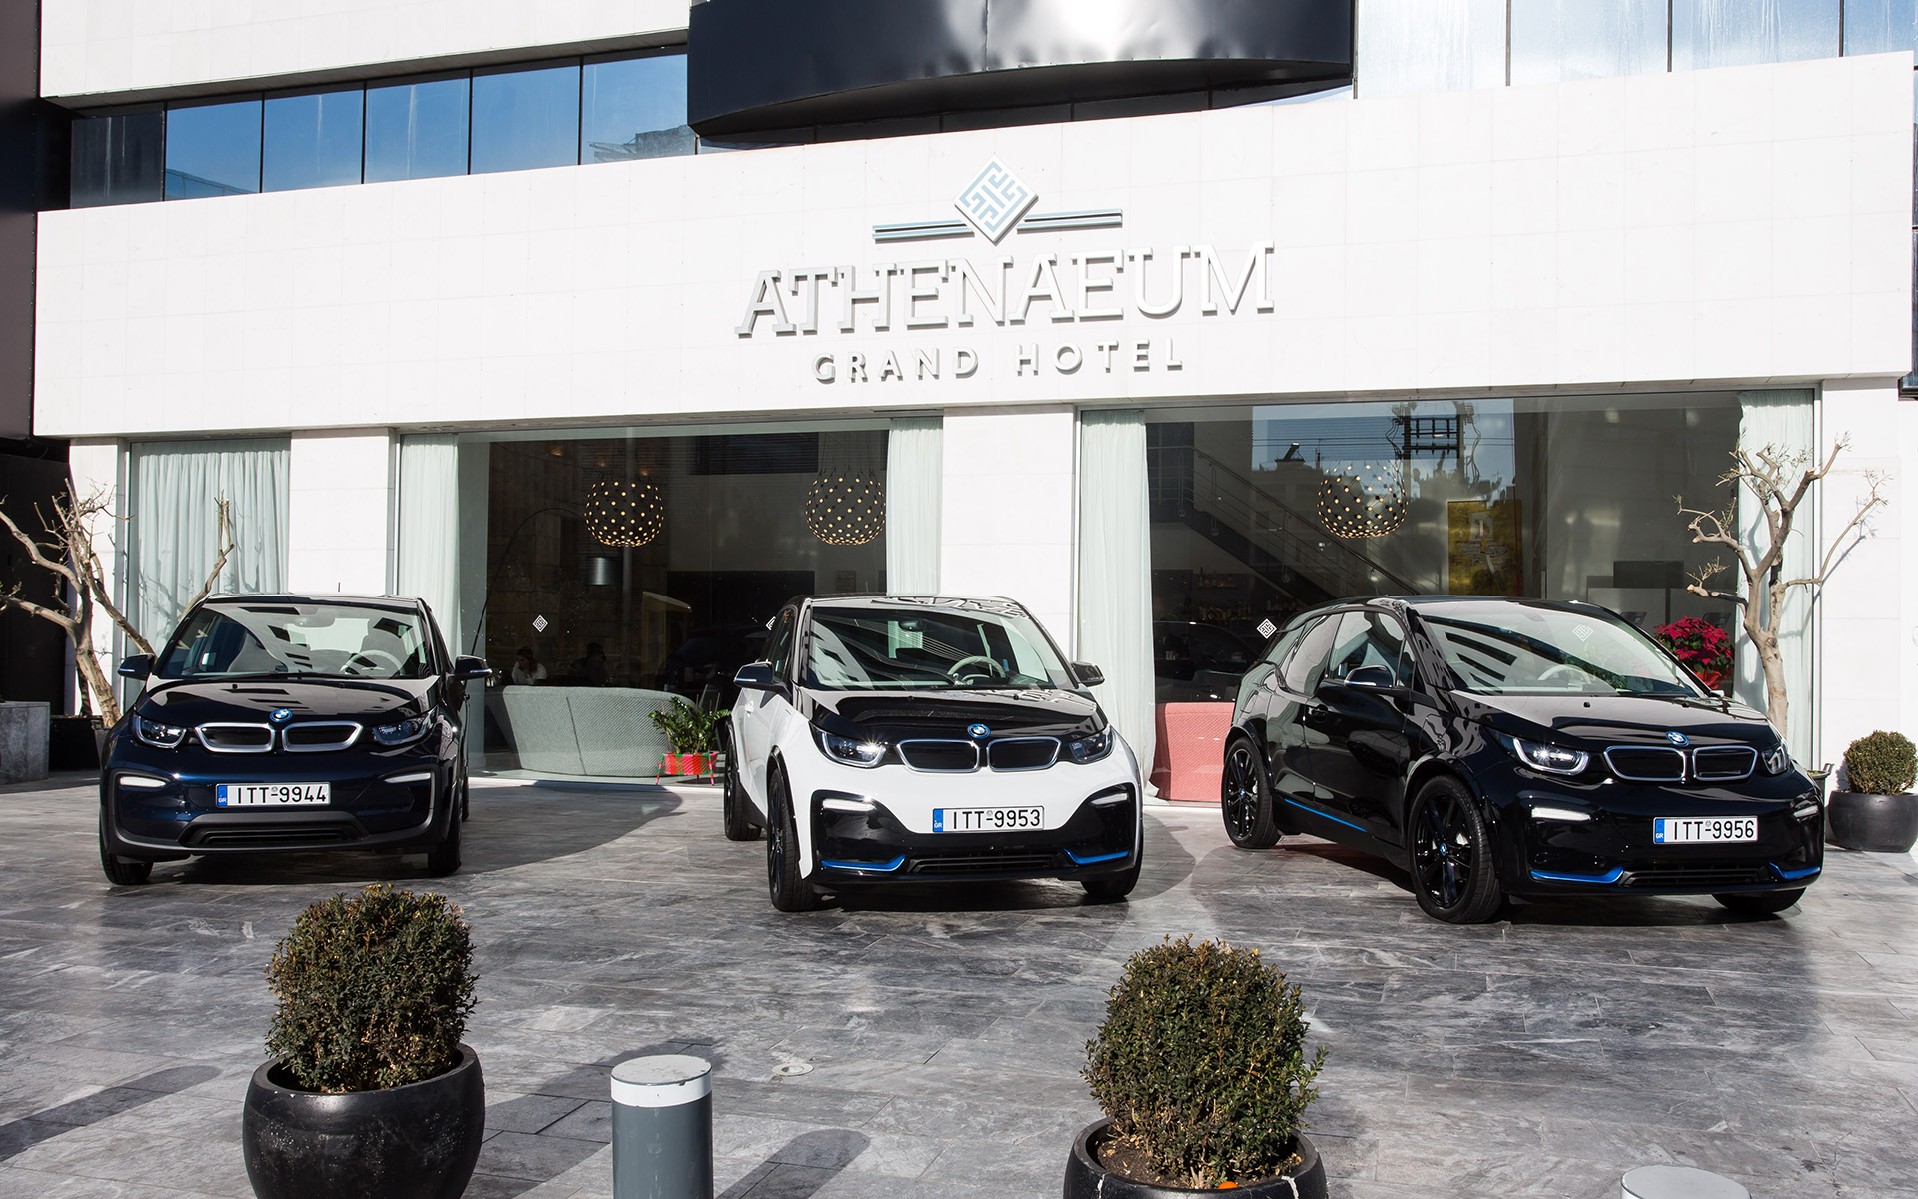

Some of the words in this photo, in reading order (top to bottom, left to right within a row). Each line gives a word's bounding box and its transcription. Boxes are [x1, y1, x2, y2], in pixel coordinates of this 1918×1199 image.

[734, 241, 1275, 339] ATHENAEUM
[811, 345, 979, 384] GRAND
[1014, 337, 1184, 376] HOTEL
